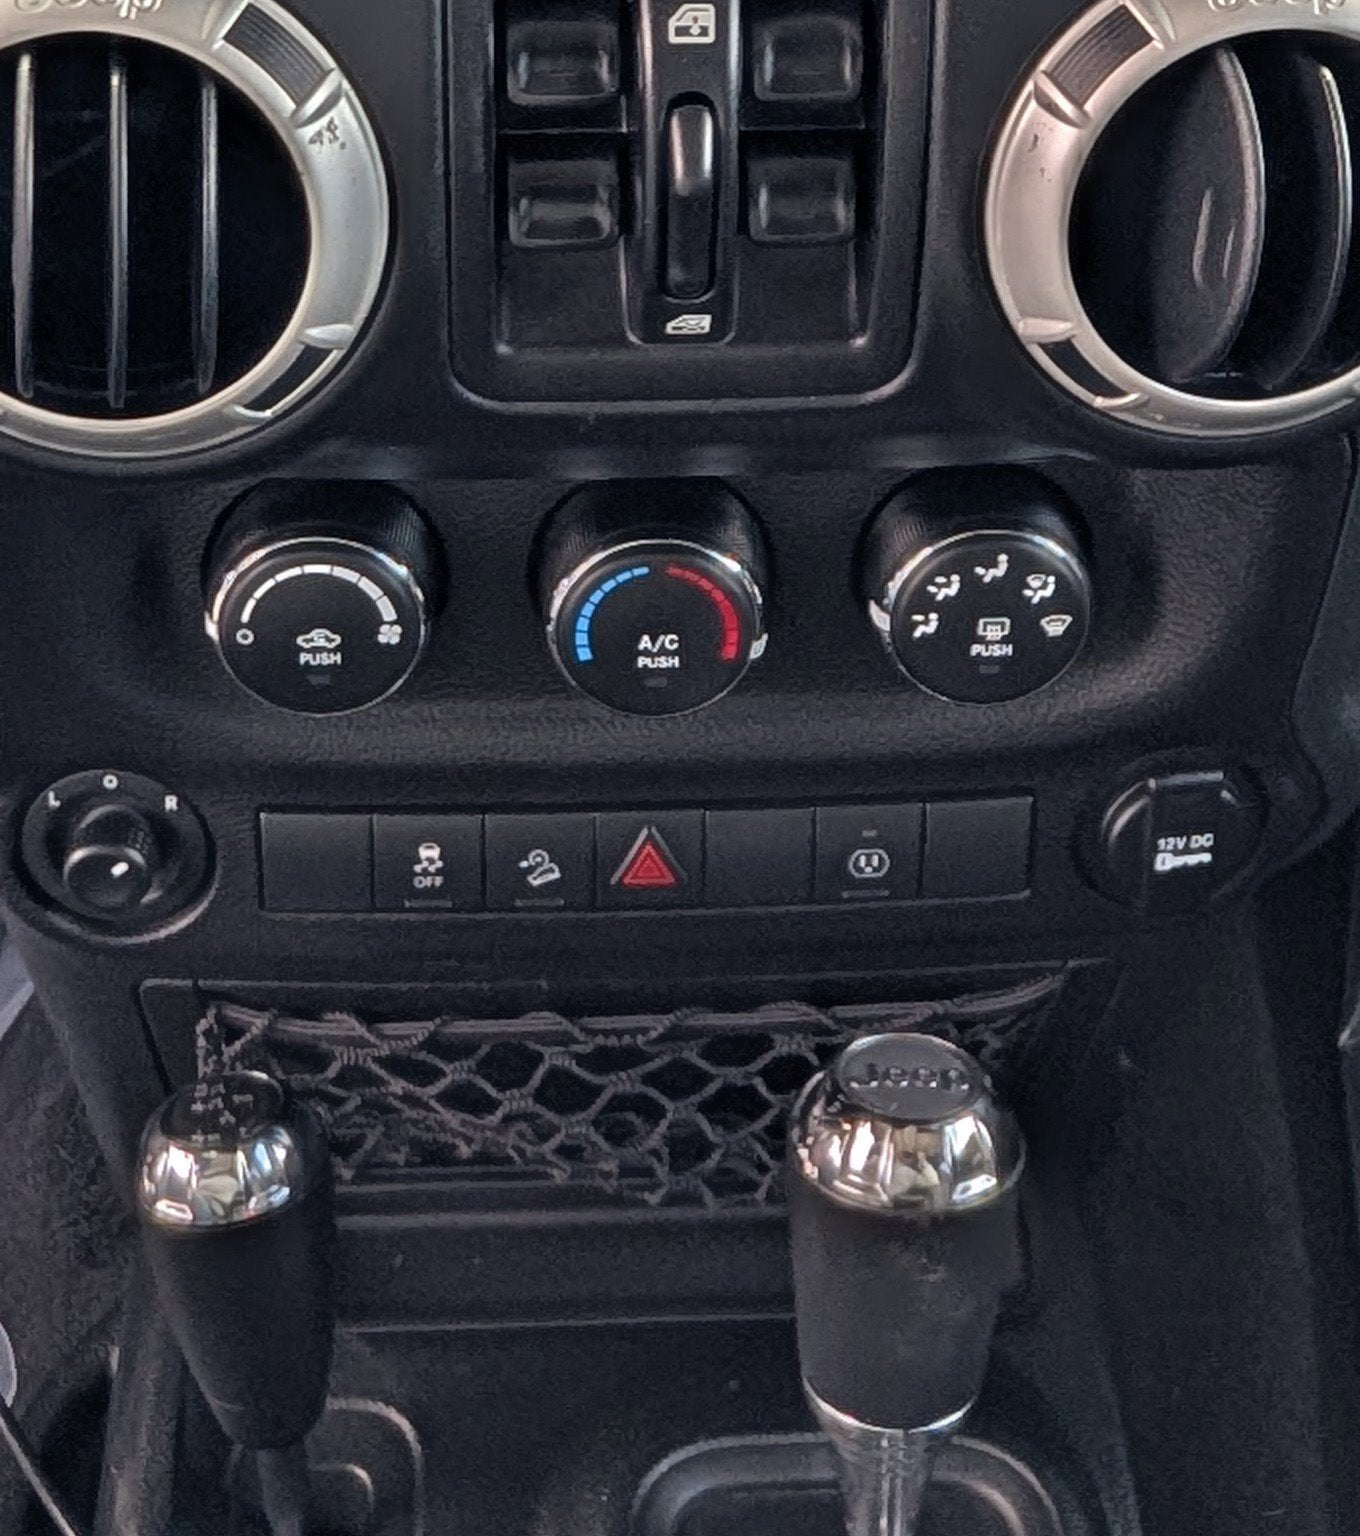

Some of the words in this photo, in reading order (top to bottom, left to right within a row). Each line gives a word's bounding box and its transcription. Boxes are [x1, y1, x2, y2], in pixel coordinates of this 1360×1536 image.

[638, 634, 680, 651] A/C
[970, 643, 1013, 658] PUSH
[299, 651, 342, 667] PUSH
[638, 655, 680, 670] PUSH
[48, 791, 60, 808] L
[165, 795, 178, 811] R
[1157, 835, 1187, 852] 12V
[413, 876, 444, 889] OFF
